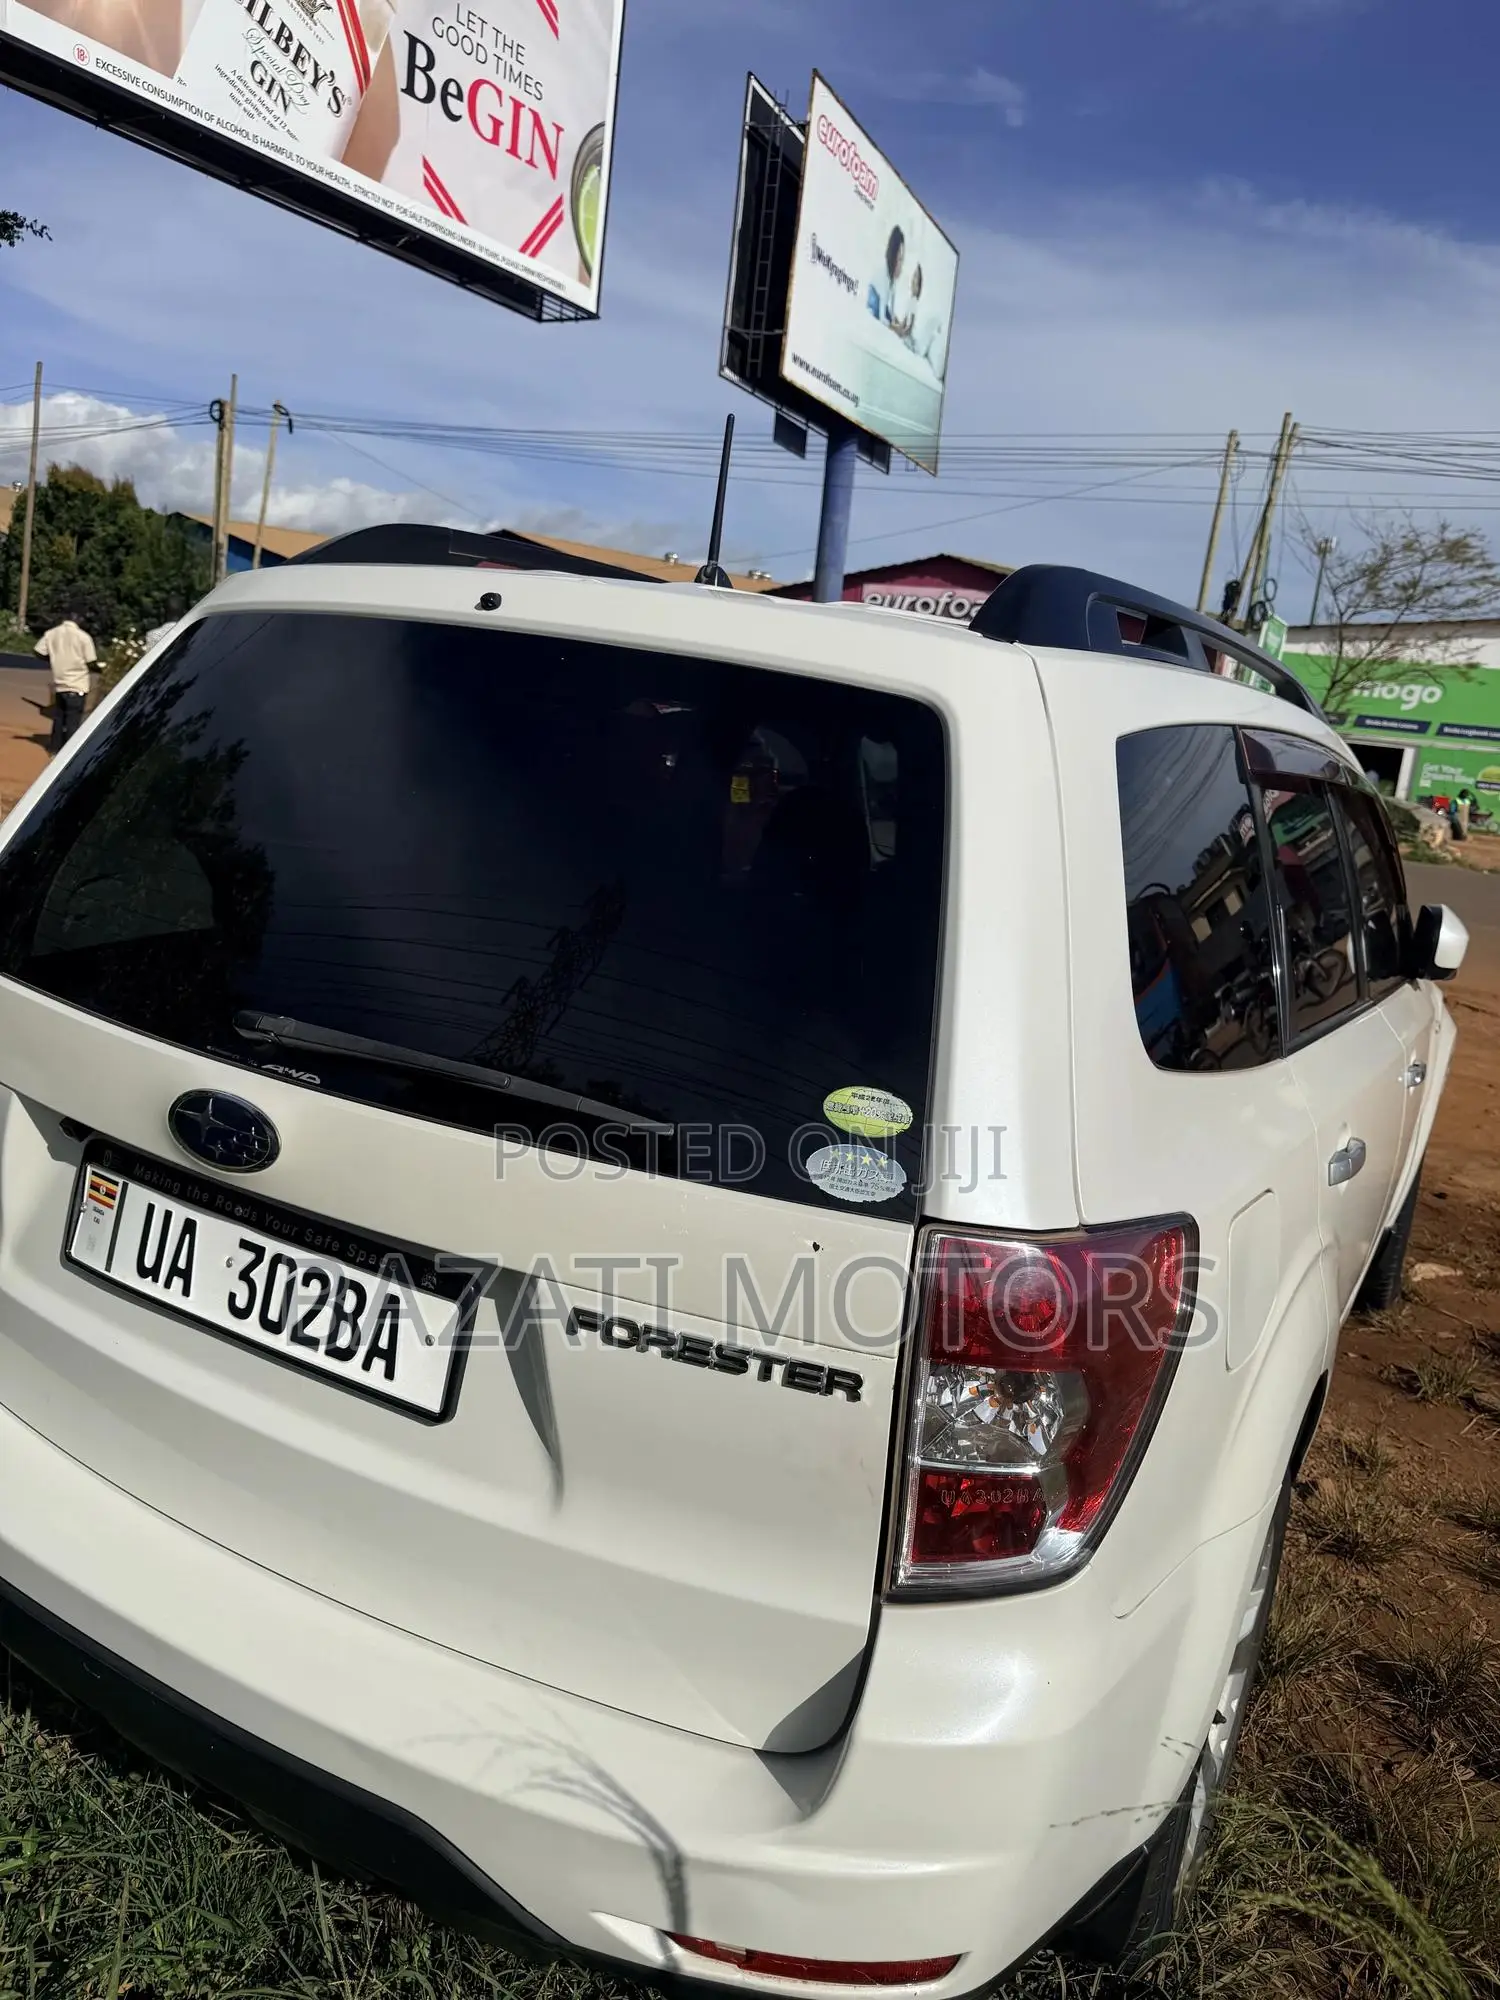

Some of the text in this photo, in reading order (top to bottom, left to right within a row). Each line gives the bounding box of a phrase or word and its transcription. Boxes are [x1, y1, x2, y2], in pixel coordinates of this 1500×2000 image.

[236, 0, 346, 118] ILBEY'S
[432, 16, 543, 101] GOOD TIMES
[456, 3, 526, 66] LET THE
[95, 57, 141, 88] EXCESSIVE
[141, 80, 203, 119] CONSUMPTION
[204, 111, 215, 123] OF
[215, 116, 252, 141] ALCOHOL
[252, 133, 260, 145] IS
[260, 137, 294, 163] HARMFUL
[295, 155, 305, 166] TO
[306, 159, 325, 177] YOUR
[236, 75, 258, 98] delicate
[250, 59, 293, 116] GIN
[400, 30, 565, 181] BeGIN
[817, 114, 879, 201] eurofoam
[261, 1063, 321, 1085] AWD
[133, 1162, 398, 1273] Making the Roads Your Safe Space
[136, 1202, 402, 1382] UA 302BA
[565, 1305, 865, 1403] FORESTER
